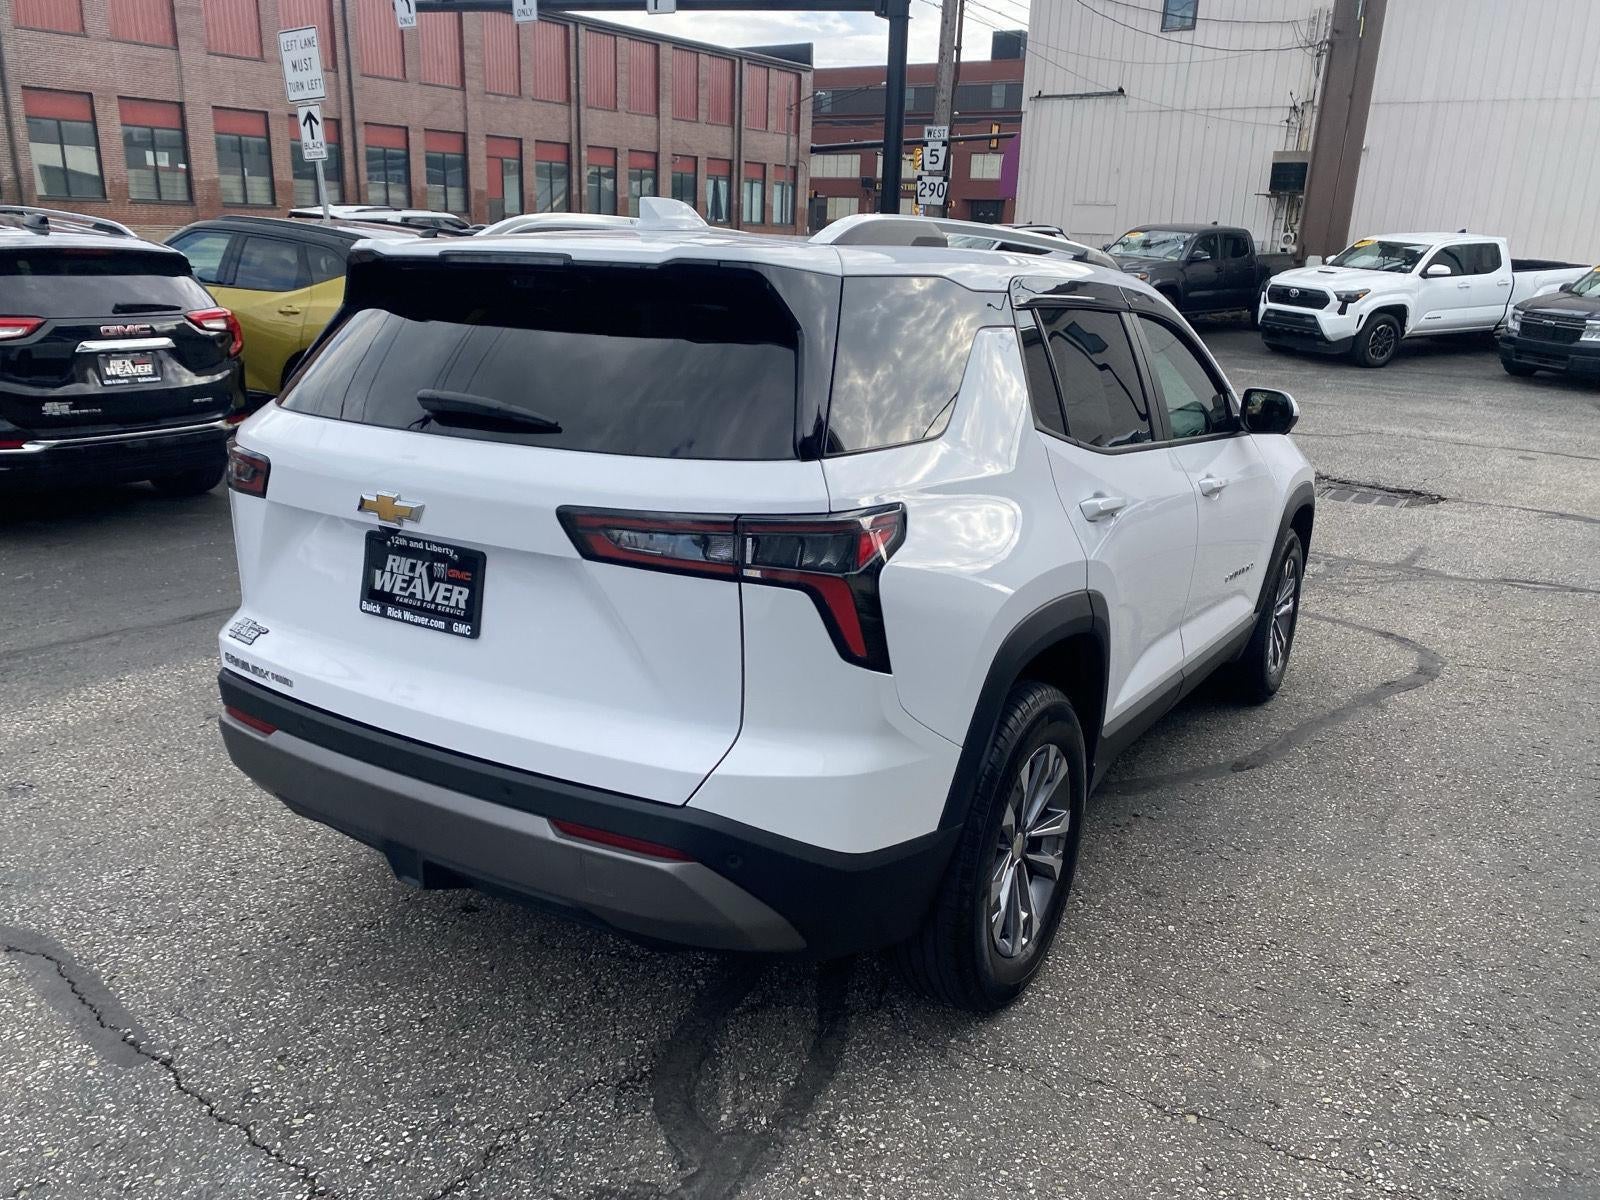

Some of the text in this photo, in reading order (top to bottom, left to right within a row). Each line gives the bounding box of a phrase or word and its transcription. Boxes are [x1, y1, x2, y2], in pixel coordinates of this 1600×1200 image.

[516, 8, 533, 17] ONLY
[399, 16, 414, 25] ONLY
[282, 36, 316, 52] LEFT LANE
[291, 57, 313, 73] MUST
[288, 78, 322, 93] TURN LEFT
[927, 128, 946, 139] WEST
[304, 141, 324, 150] BLACK
[929, 149, 939, 164] 5
[919, 182, 945, 198] 290
[100, 324, 151, 336] GMC
[105, 364, 153, 375] WEAVER
[110, 360, 133, 368] RICK
[391, 536, 454, 557] 12th and Liberty
[385, 554, 431, 577] RICK
[447, 569, 472, 581] GMC
[374, 569, 470, 609] WEAVER
[395, 596, 465, 617] FAMOUS FOR SERVICE
[361, 600, 471, 635] Buick Rick Weaver.com GMC
